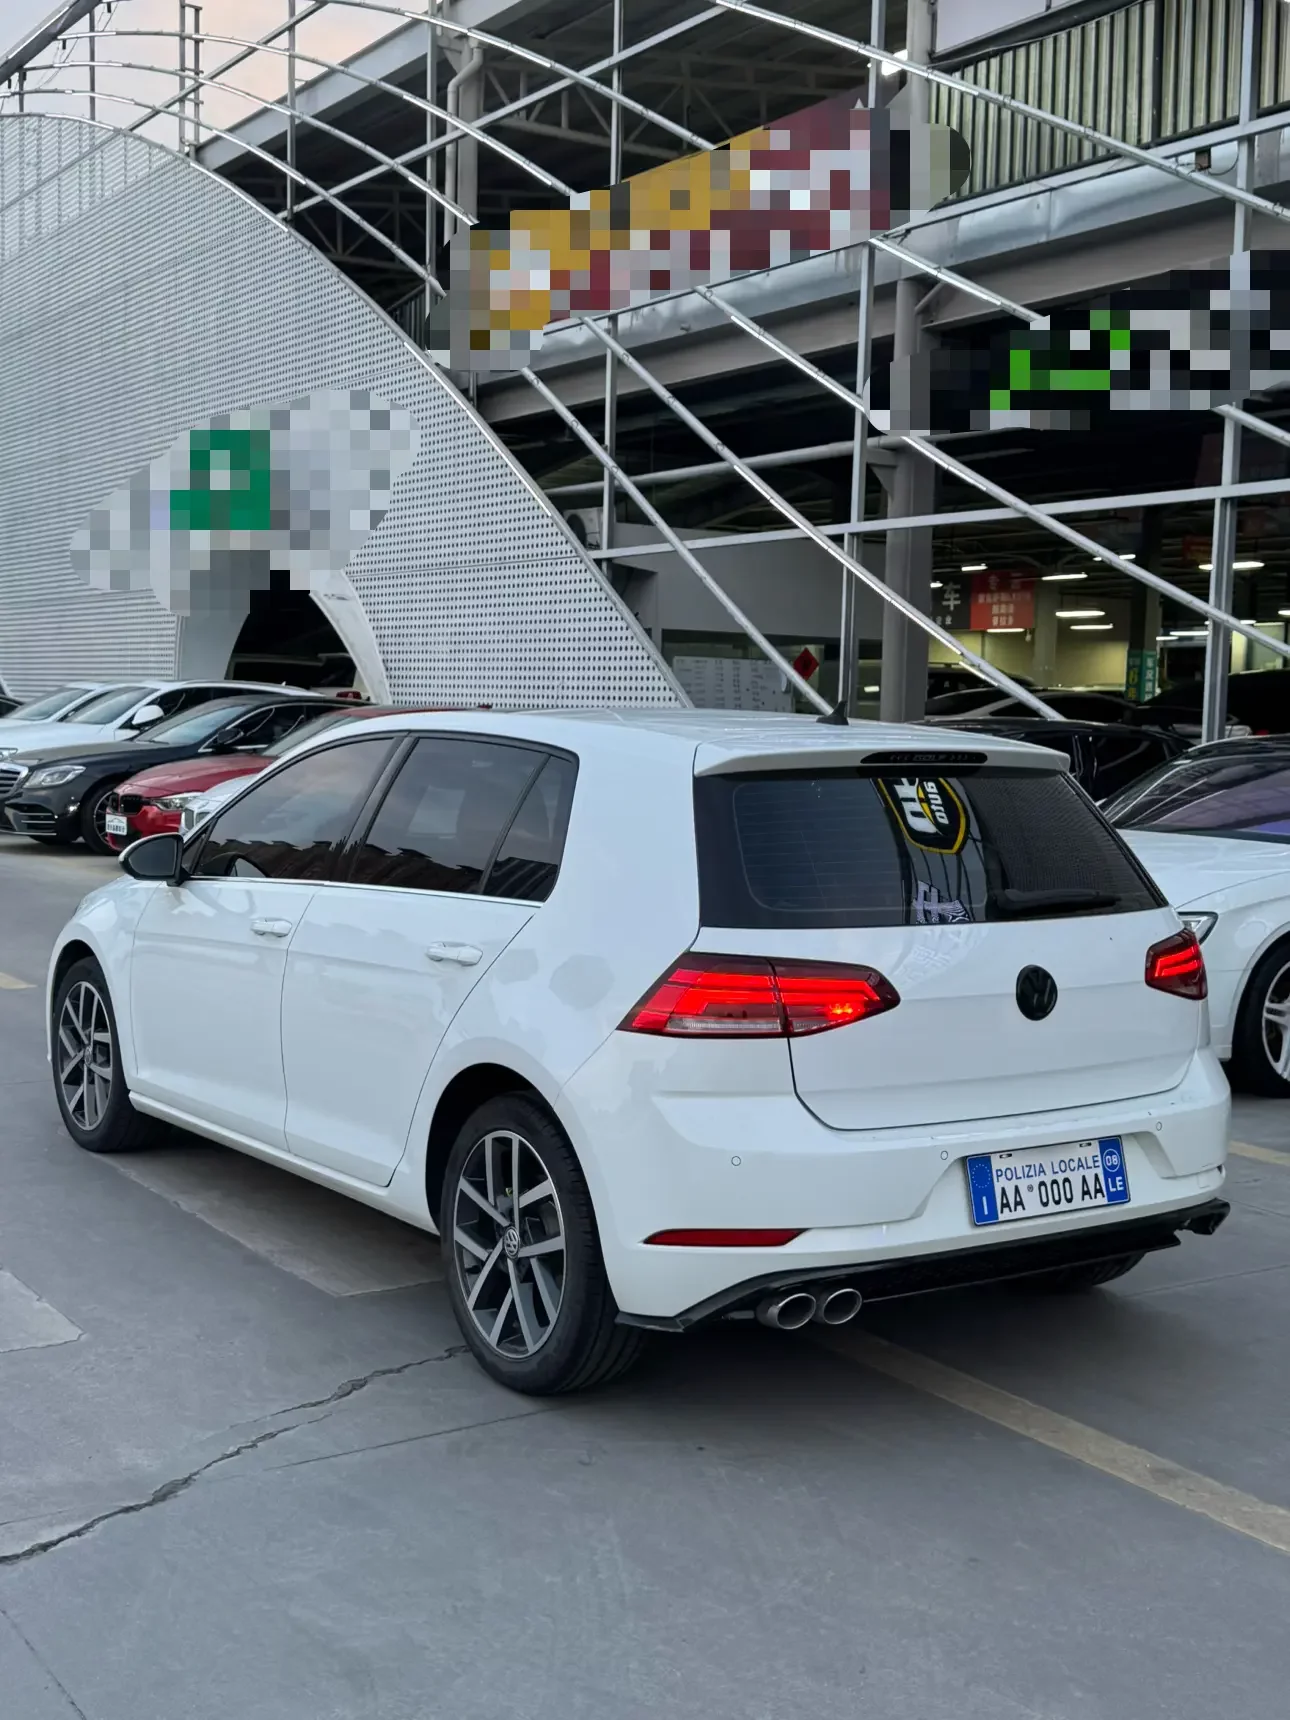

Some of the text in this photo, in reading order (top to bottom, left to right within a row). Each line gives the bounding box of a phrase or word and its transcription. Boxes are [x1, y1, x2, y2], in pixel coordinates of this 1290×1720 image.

[996, 1155, 1100, 1183] POLIZIA LOCALE
[1105, 1154, 1118, 1166] 08
[1000, 1173, 1106, 1214] AA 000 AA
[1108, 1176, 1124, 1192] LE
[982, 1195, 988, 1216] I
